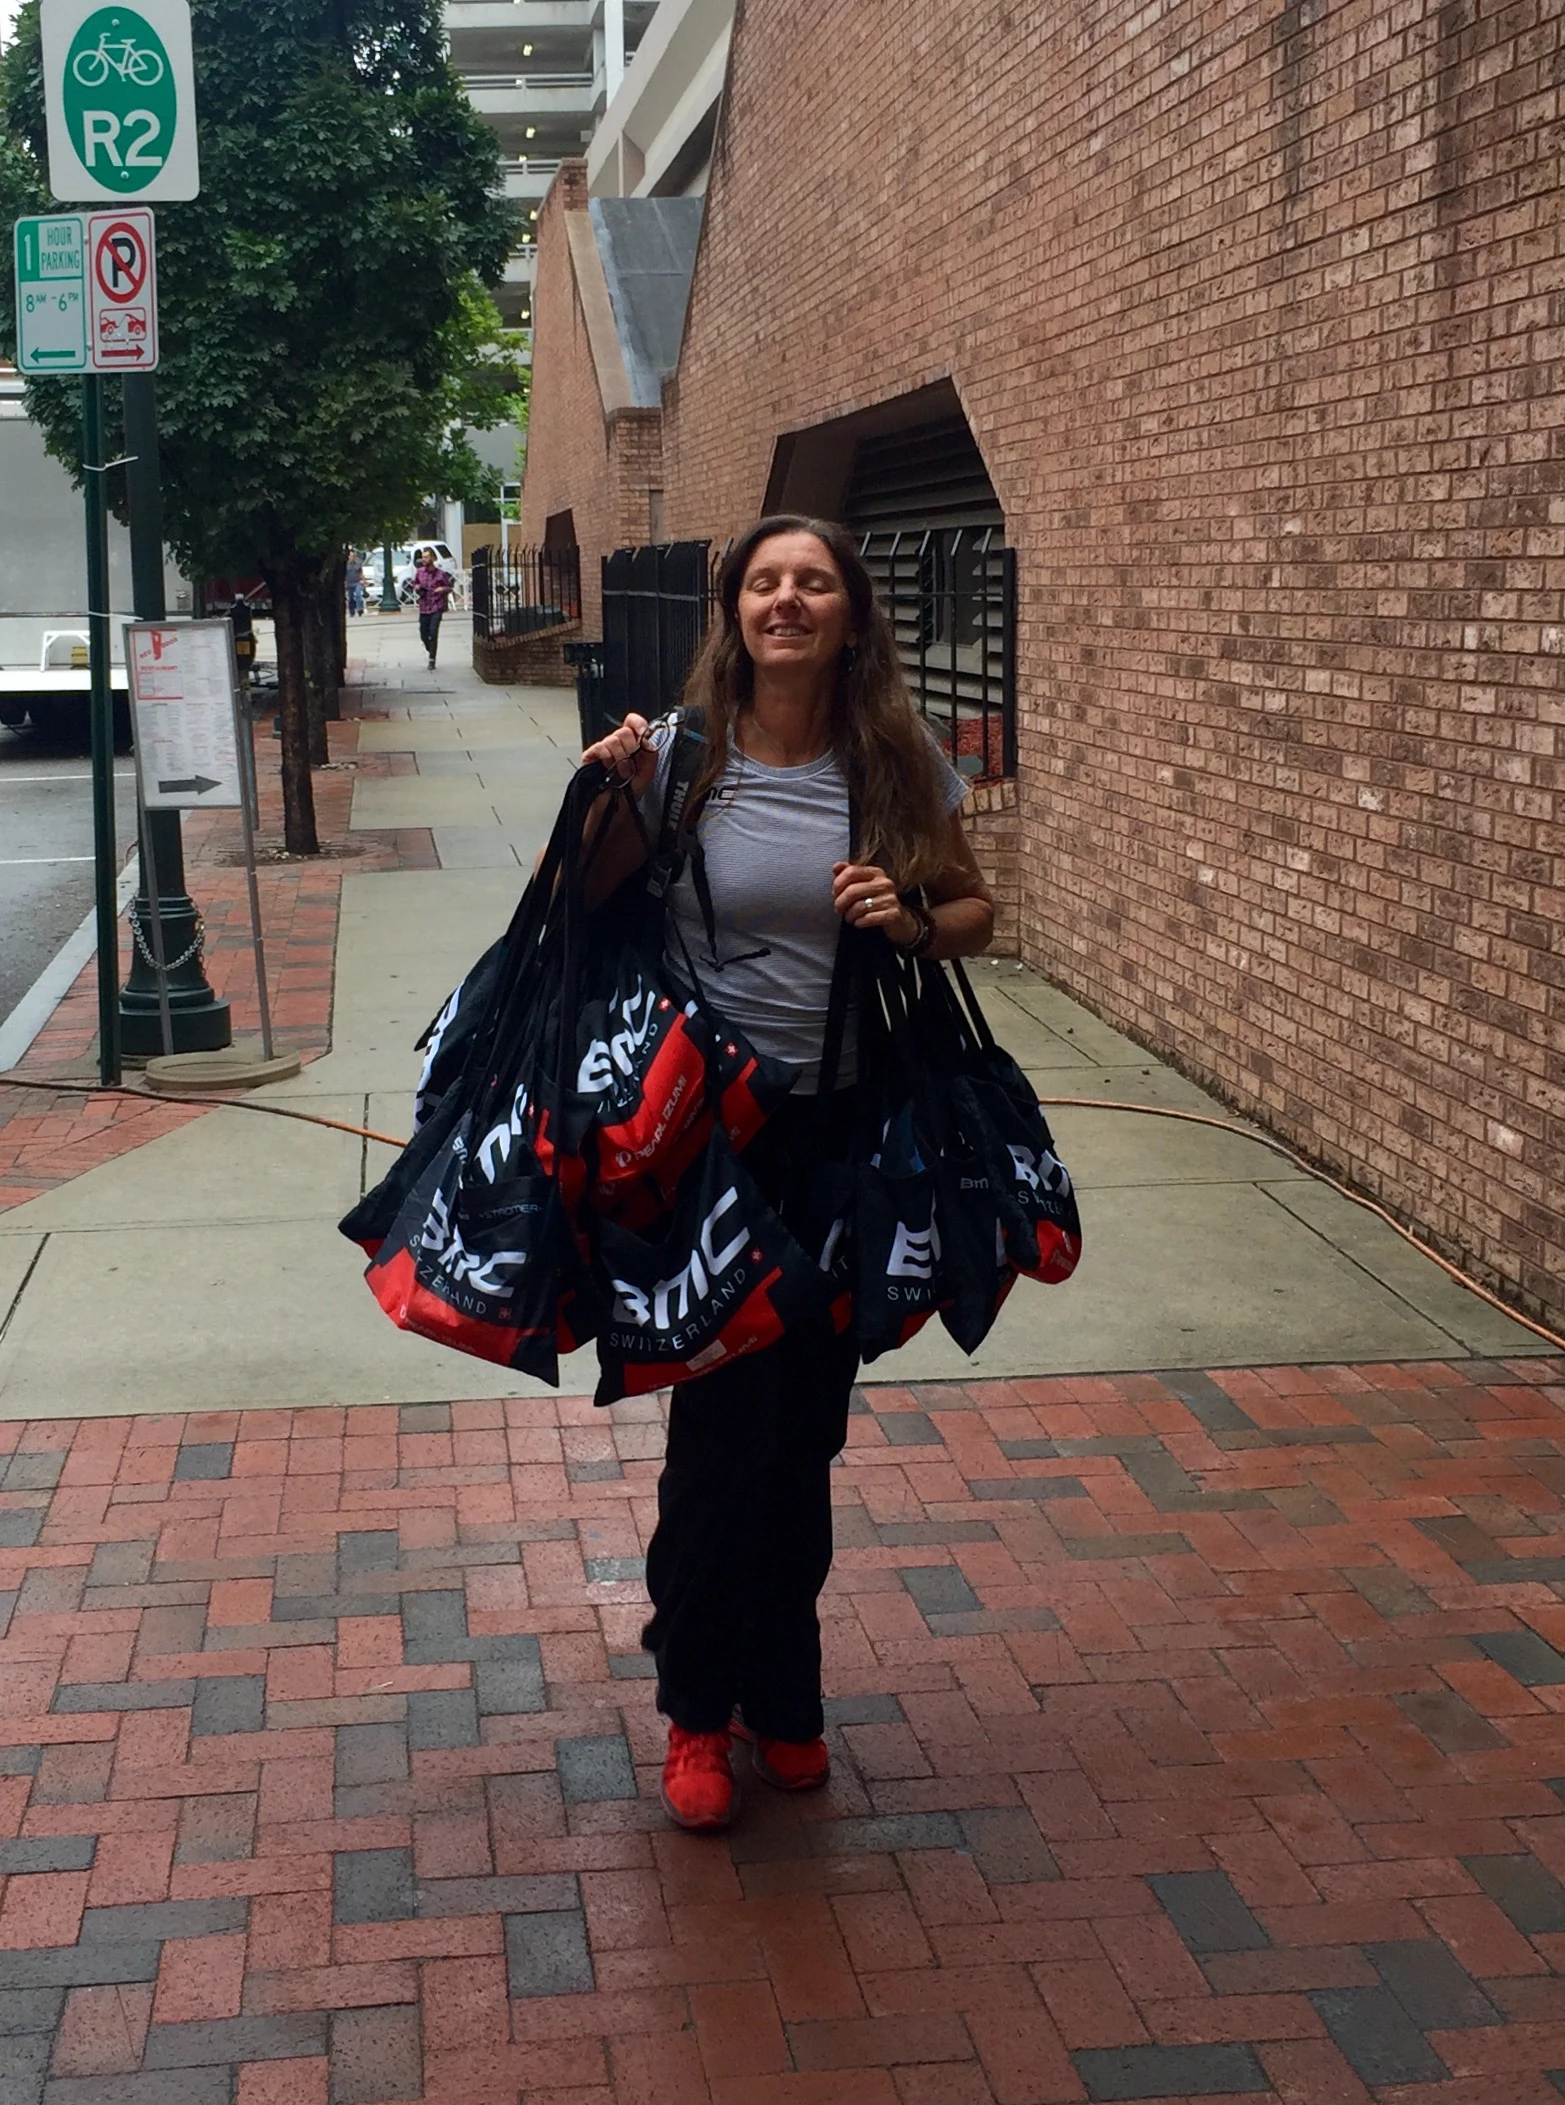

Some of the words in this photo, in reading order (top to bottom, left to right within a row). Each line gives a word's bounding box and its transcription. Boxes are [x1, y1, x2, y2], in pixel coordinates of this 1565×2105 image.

[82, 109, 163, 167] R2
[24, 233, 32, 271] 1
[46, 226, 73, 247] HOUR
[41, 249, 81, 271] PARKING
[139, 649, 153, 659] RED
[161, 637, 178, 649] DOOR
[634, 1122, 667, 1160] PEARL
[662, 1074, 687, 1121] IZUMI
[611, 1186, 751, 1330] BMC
